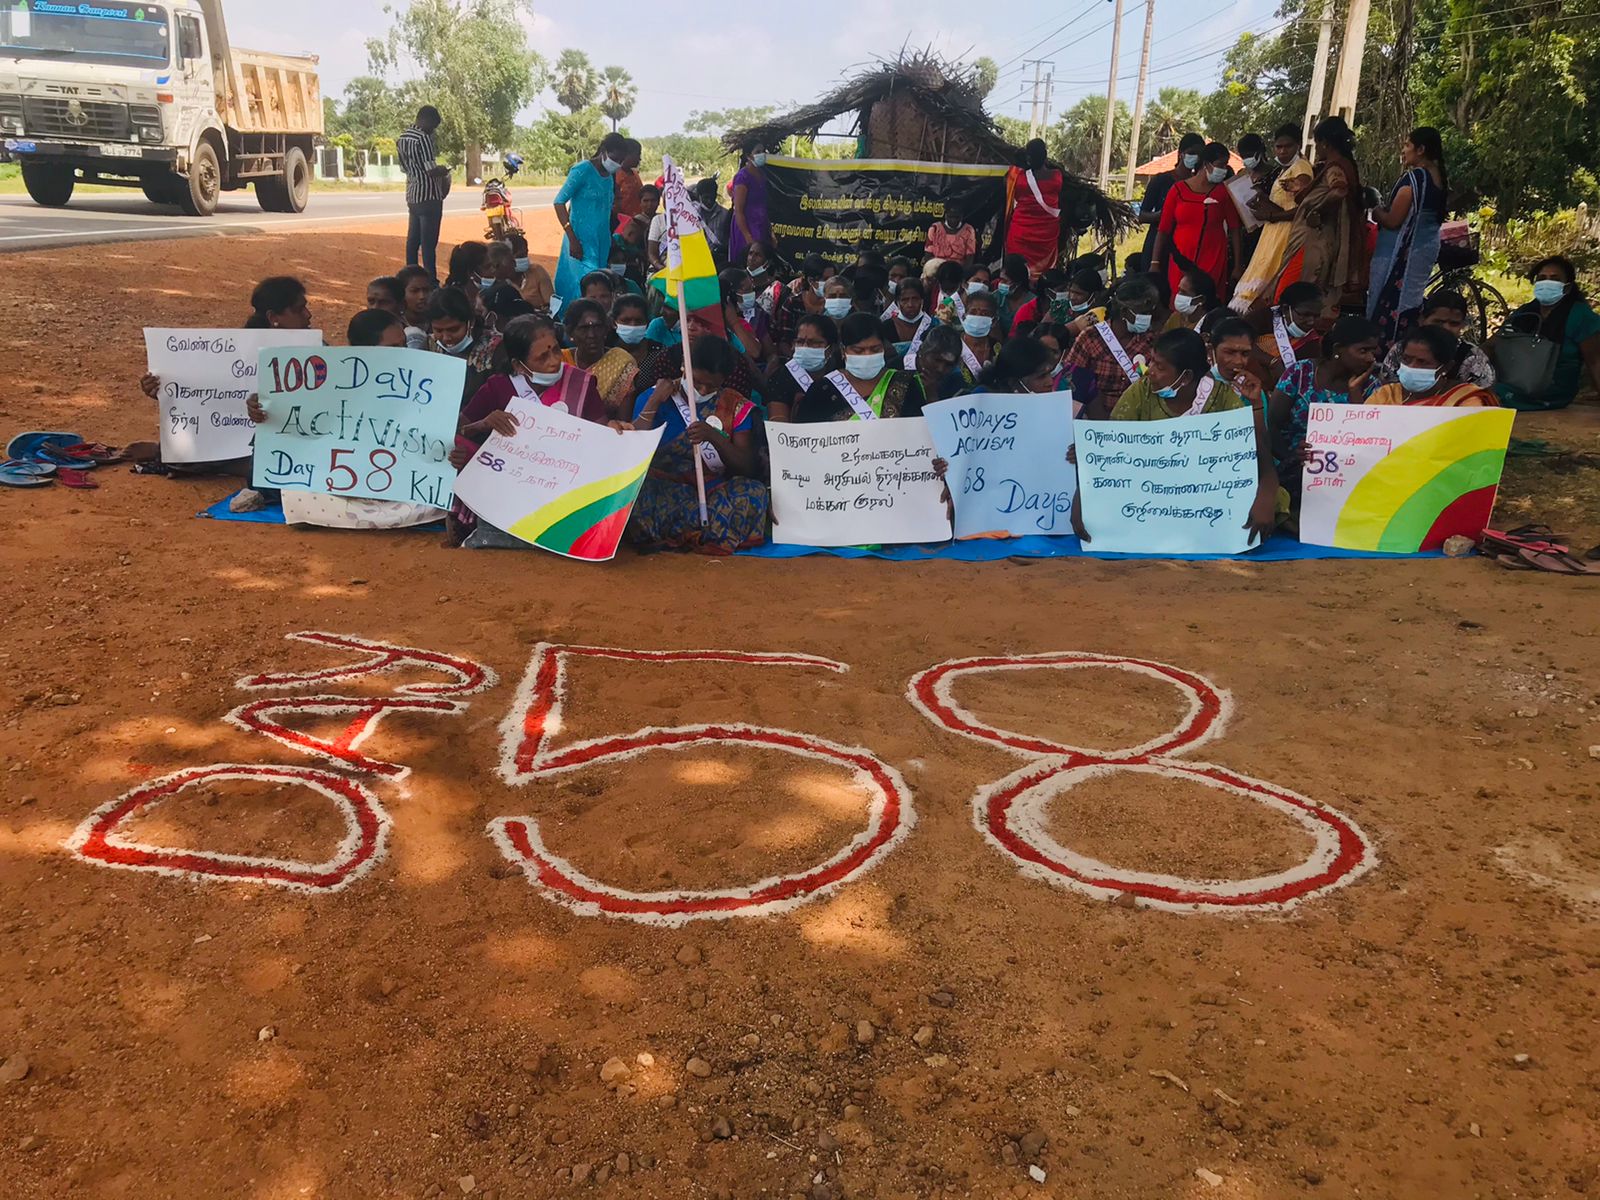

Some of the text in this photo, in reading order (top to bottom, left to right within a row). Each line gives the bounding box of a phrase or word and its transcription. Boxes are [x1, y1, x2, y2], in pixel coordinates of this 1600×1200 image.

[914, 196, 945, 217] மக்களு
[898, 226, 926, 244] அரசிய
[166, 335, 236, 353] வேண்டும்
[268, 355, 433, 405] 100 Days
[831, 372, 860, 406] DAYS
[1311, 408, 1334, 422] 100
[265, 450, 315, 487] Day
[325, 448, 397, 492] 58
[996, 478, 1071, 531] Days
[61, 630, 1381, 929] DAY 58
